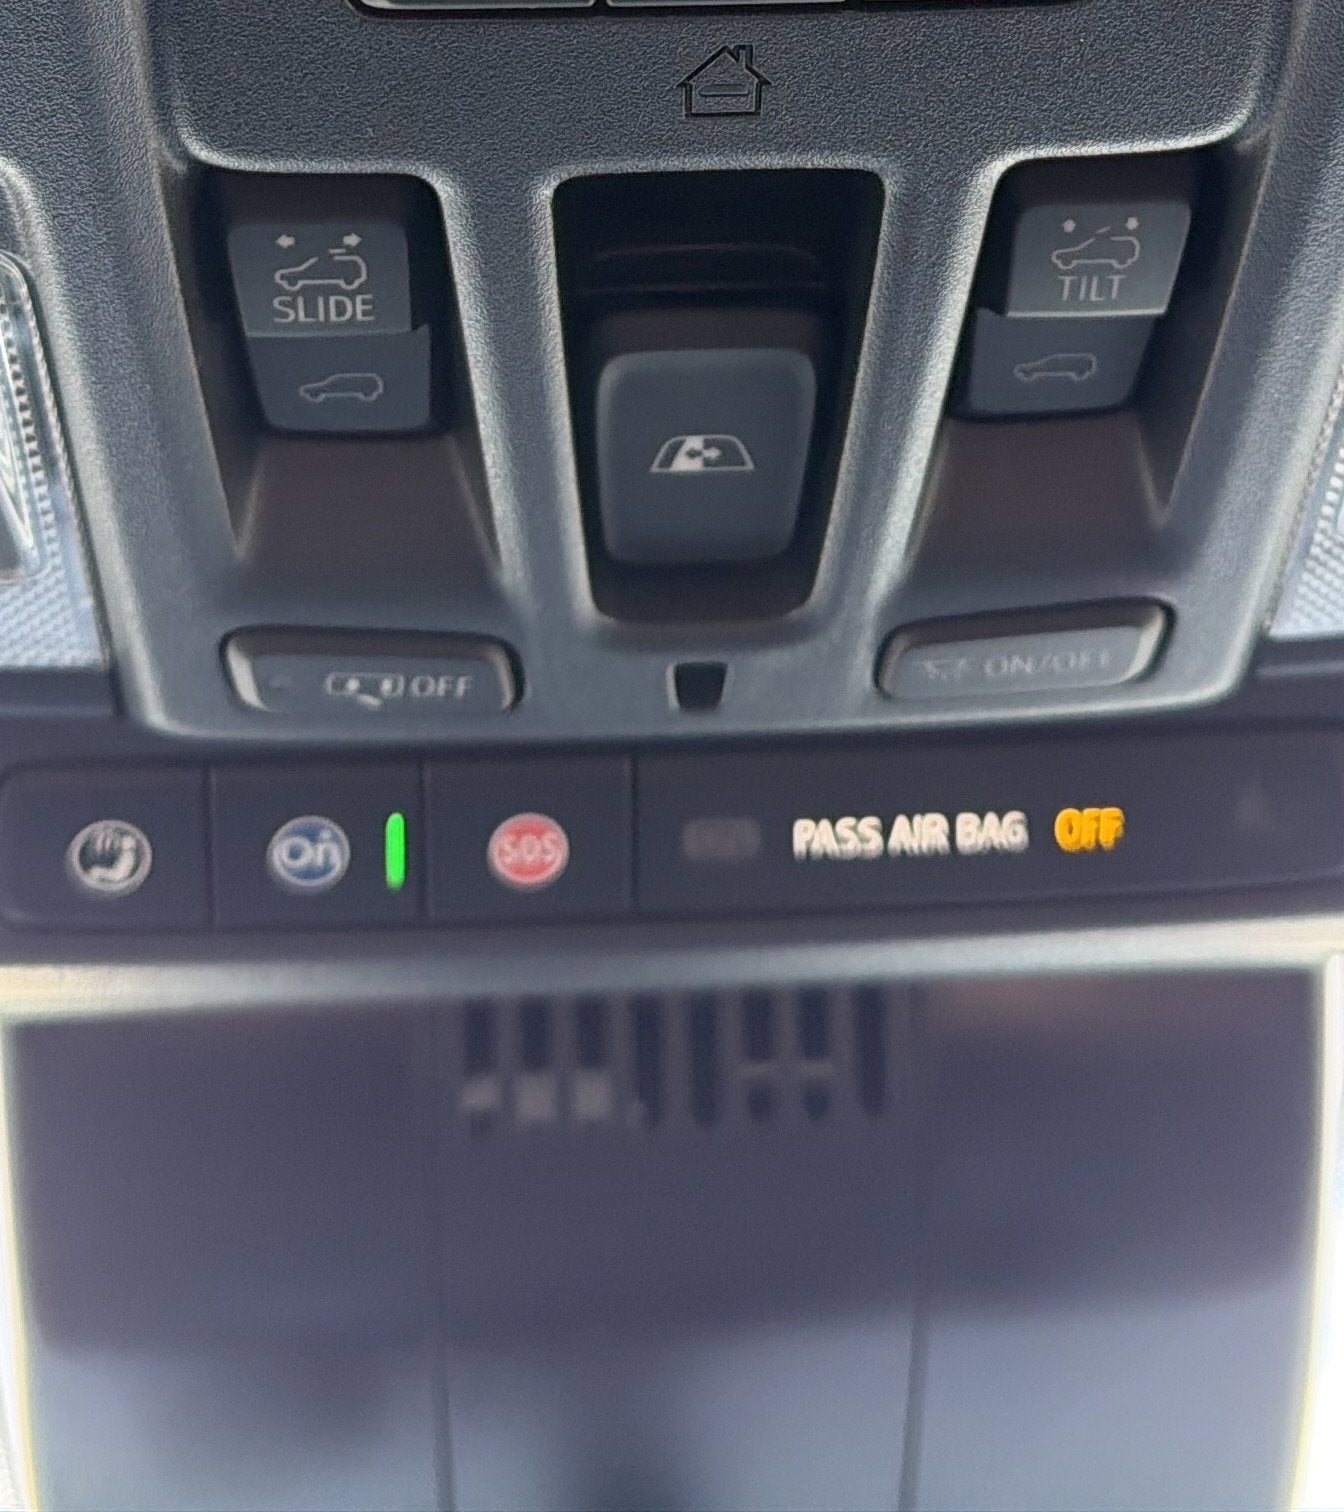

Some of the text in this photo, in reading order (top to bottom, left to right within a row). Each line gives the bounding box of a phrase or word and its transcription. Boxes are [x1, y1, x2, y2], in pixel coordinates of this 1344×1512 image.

[1057, 274, 1127, 302] TILT
[272, 293, 376, 323] SLIDE
[497, 833, 560, 865] SOS
[792, 806, 1125, 861] PASS AIR BAG OFF
